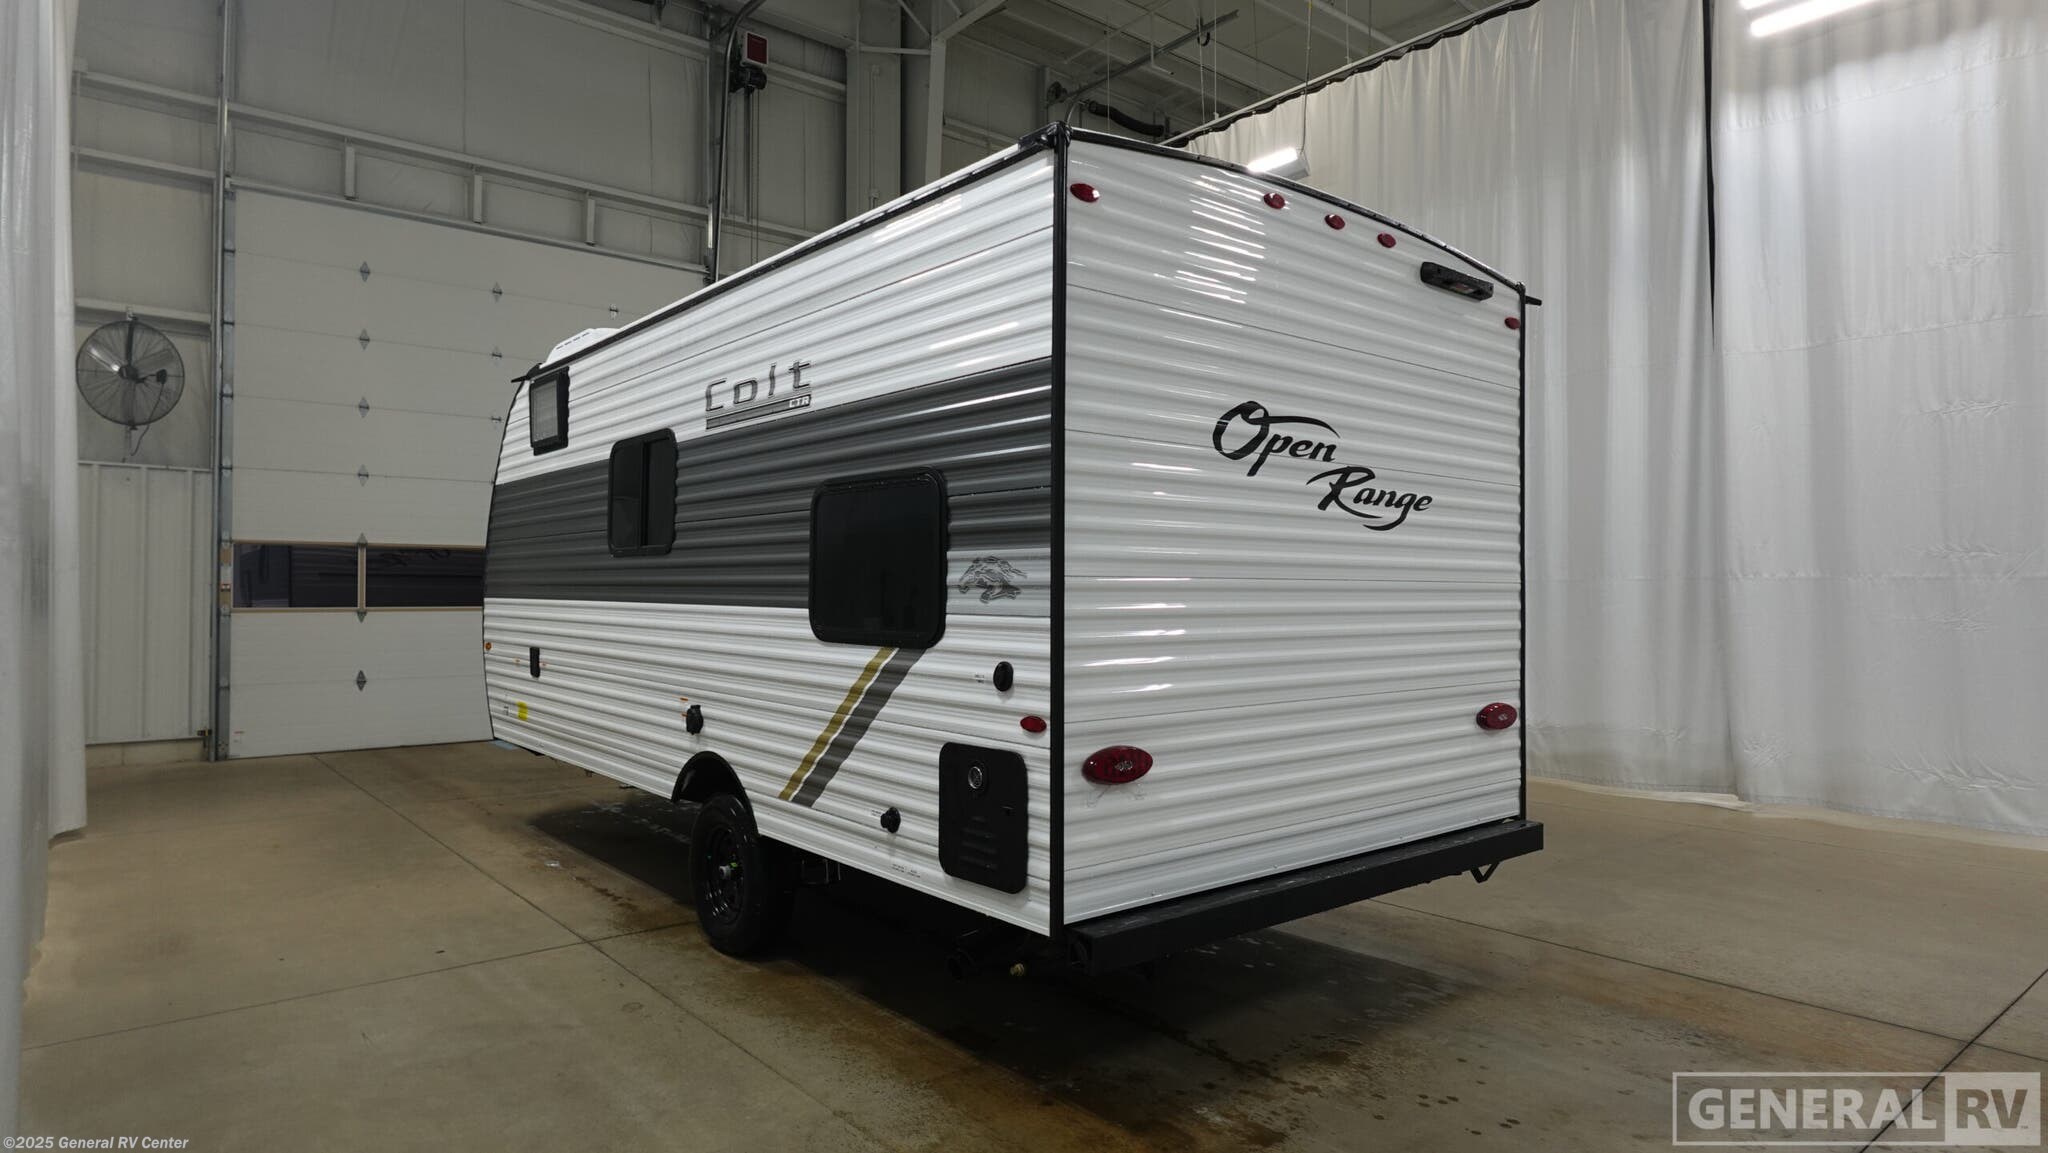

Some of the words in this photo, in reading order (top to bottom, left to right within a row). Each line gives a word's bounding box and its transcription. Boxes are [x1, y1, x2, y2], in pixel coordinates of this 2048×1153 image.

[705, 361, 810, 411] Colt
[1212, 400, 1341, 477] Open
[1306, 466, 1433, 531] Range
